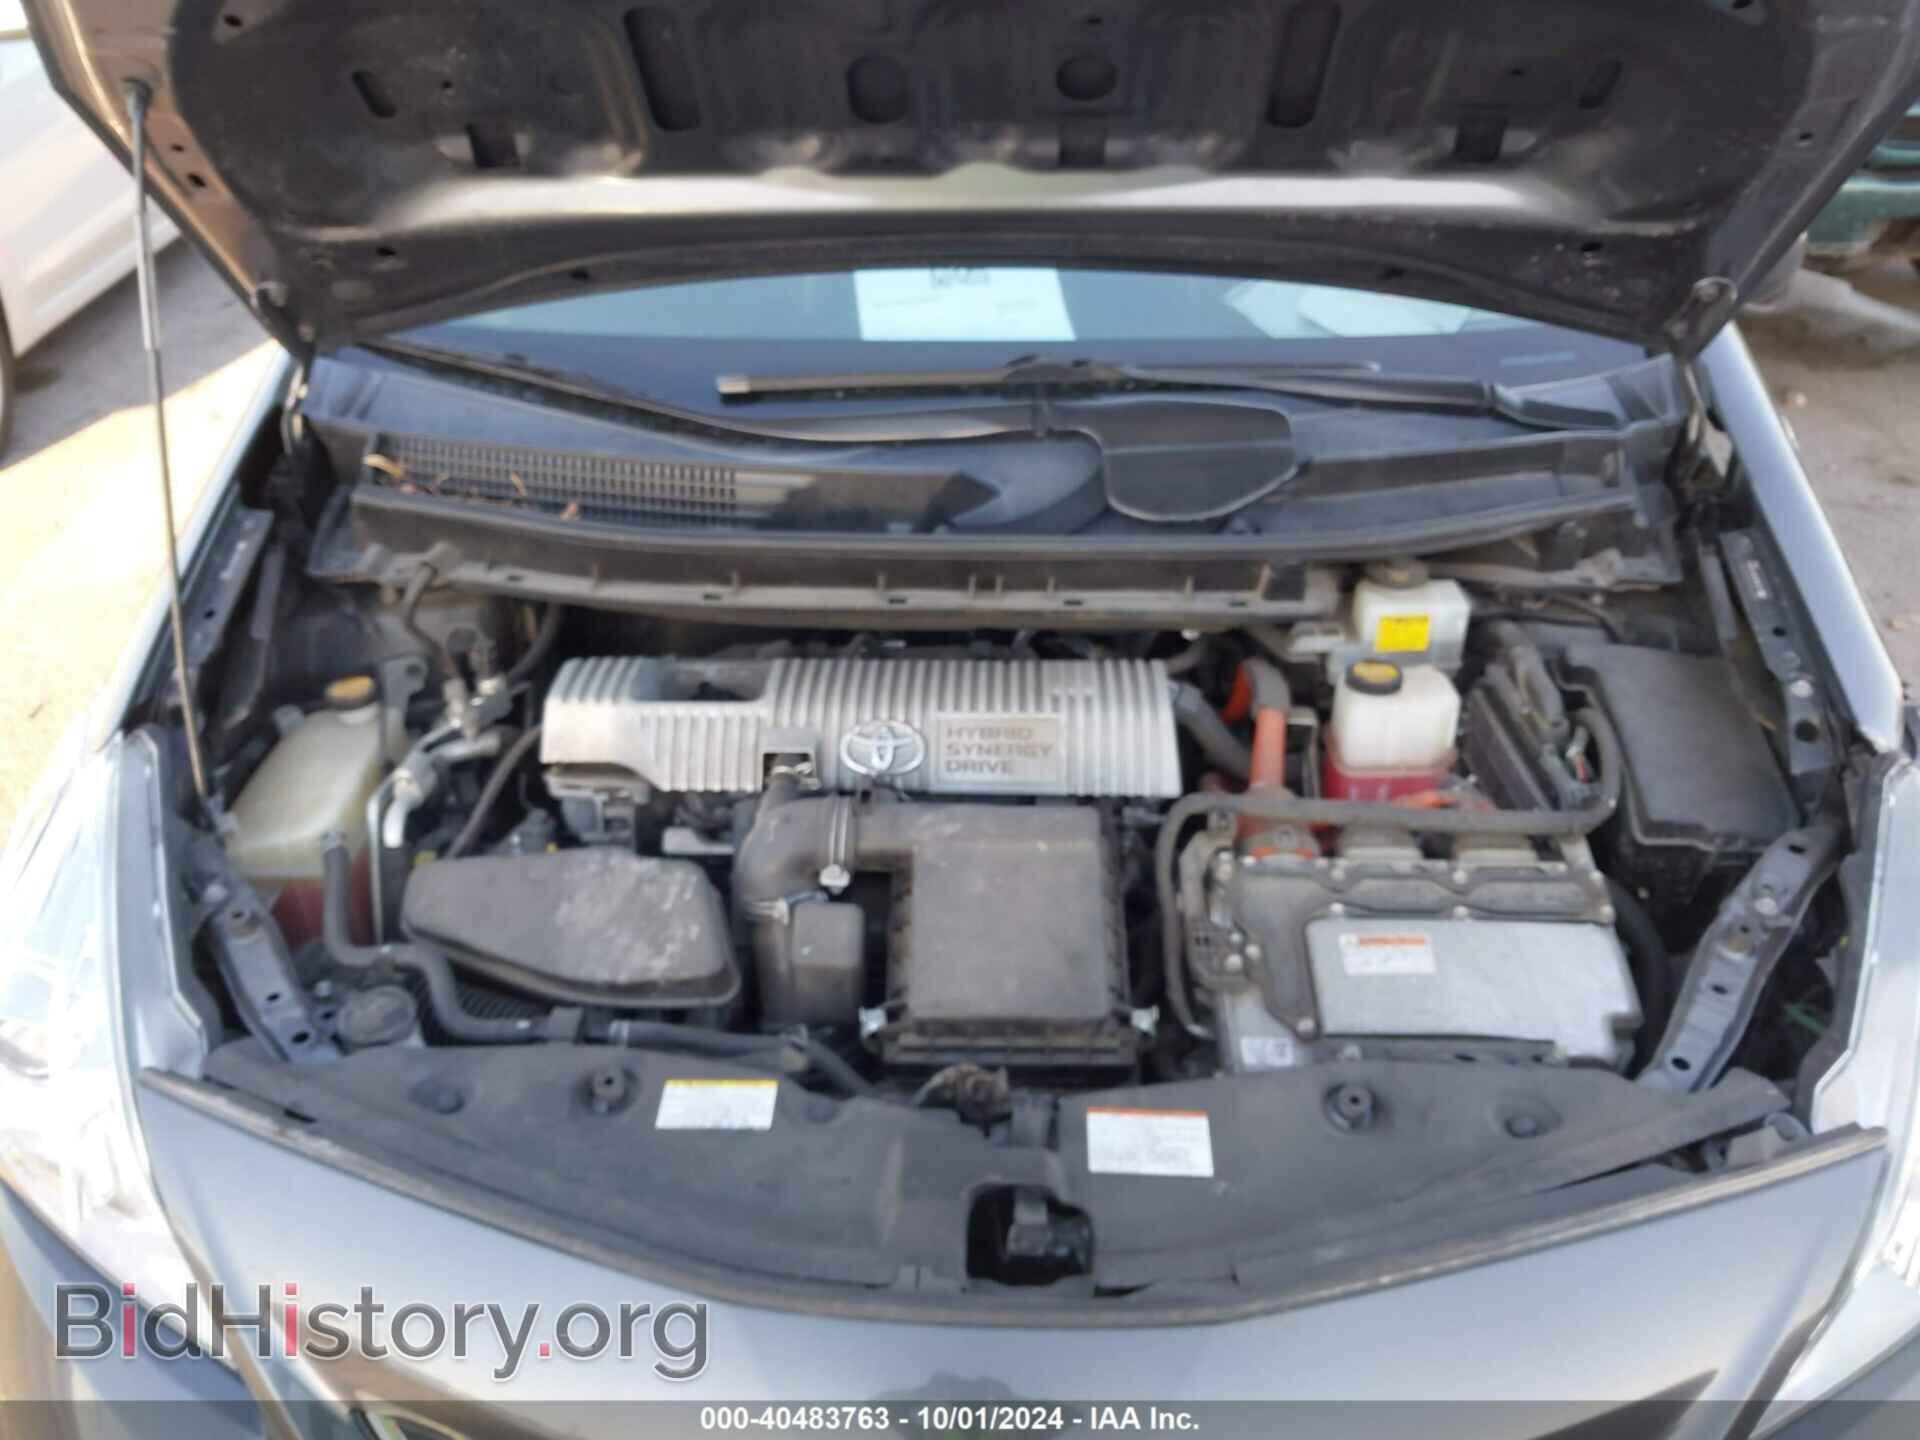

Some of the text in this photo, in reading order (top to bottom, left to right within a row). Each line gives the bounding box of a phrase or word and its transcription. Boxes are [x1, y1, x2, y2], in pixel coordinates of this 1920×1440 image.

[946, 726, 1032, 740] HYBRID
[945, 742, 1054, 757] SYNERGY
[945, 759, 1011, 774] DRIVE
